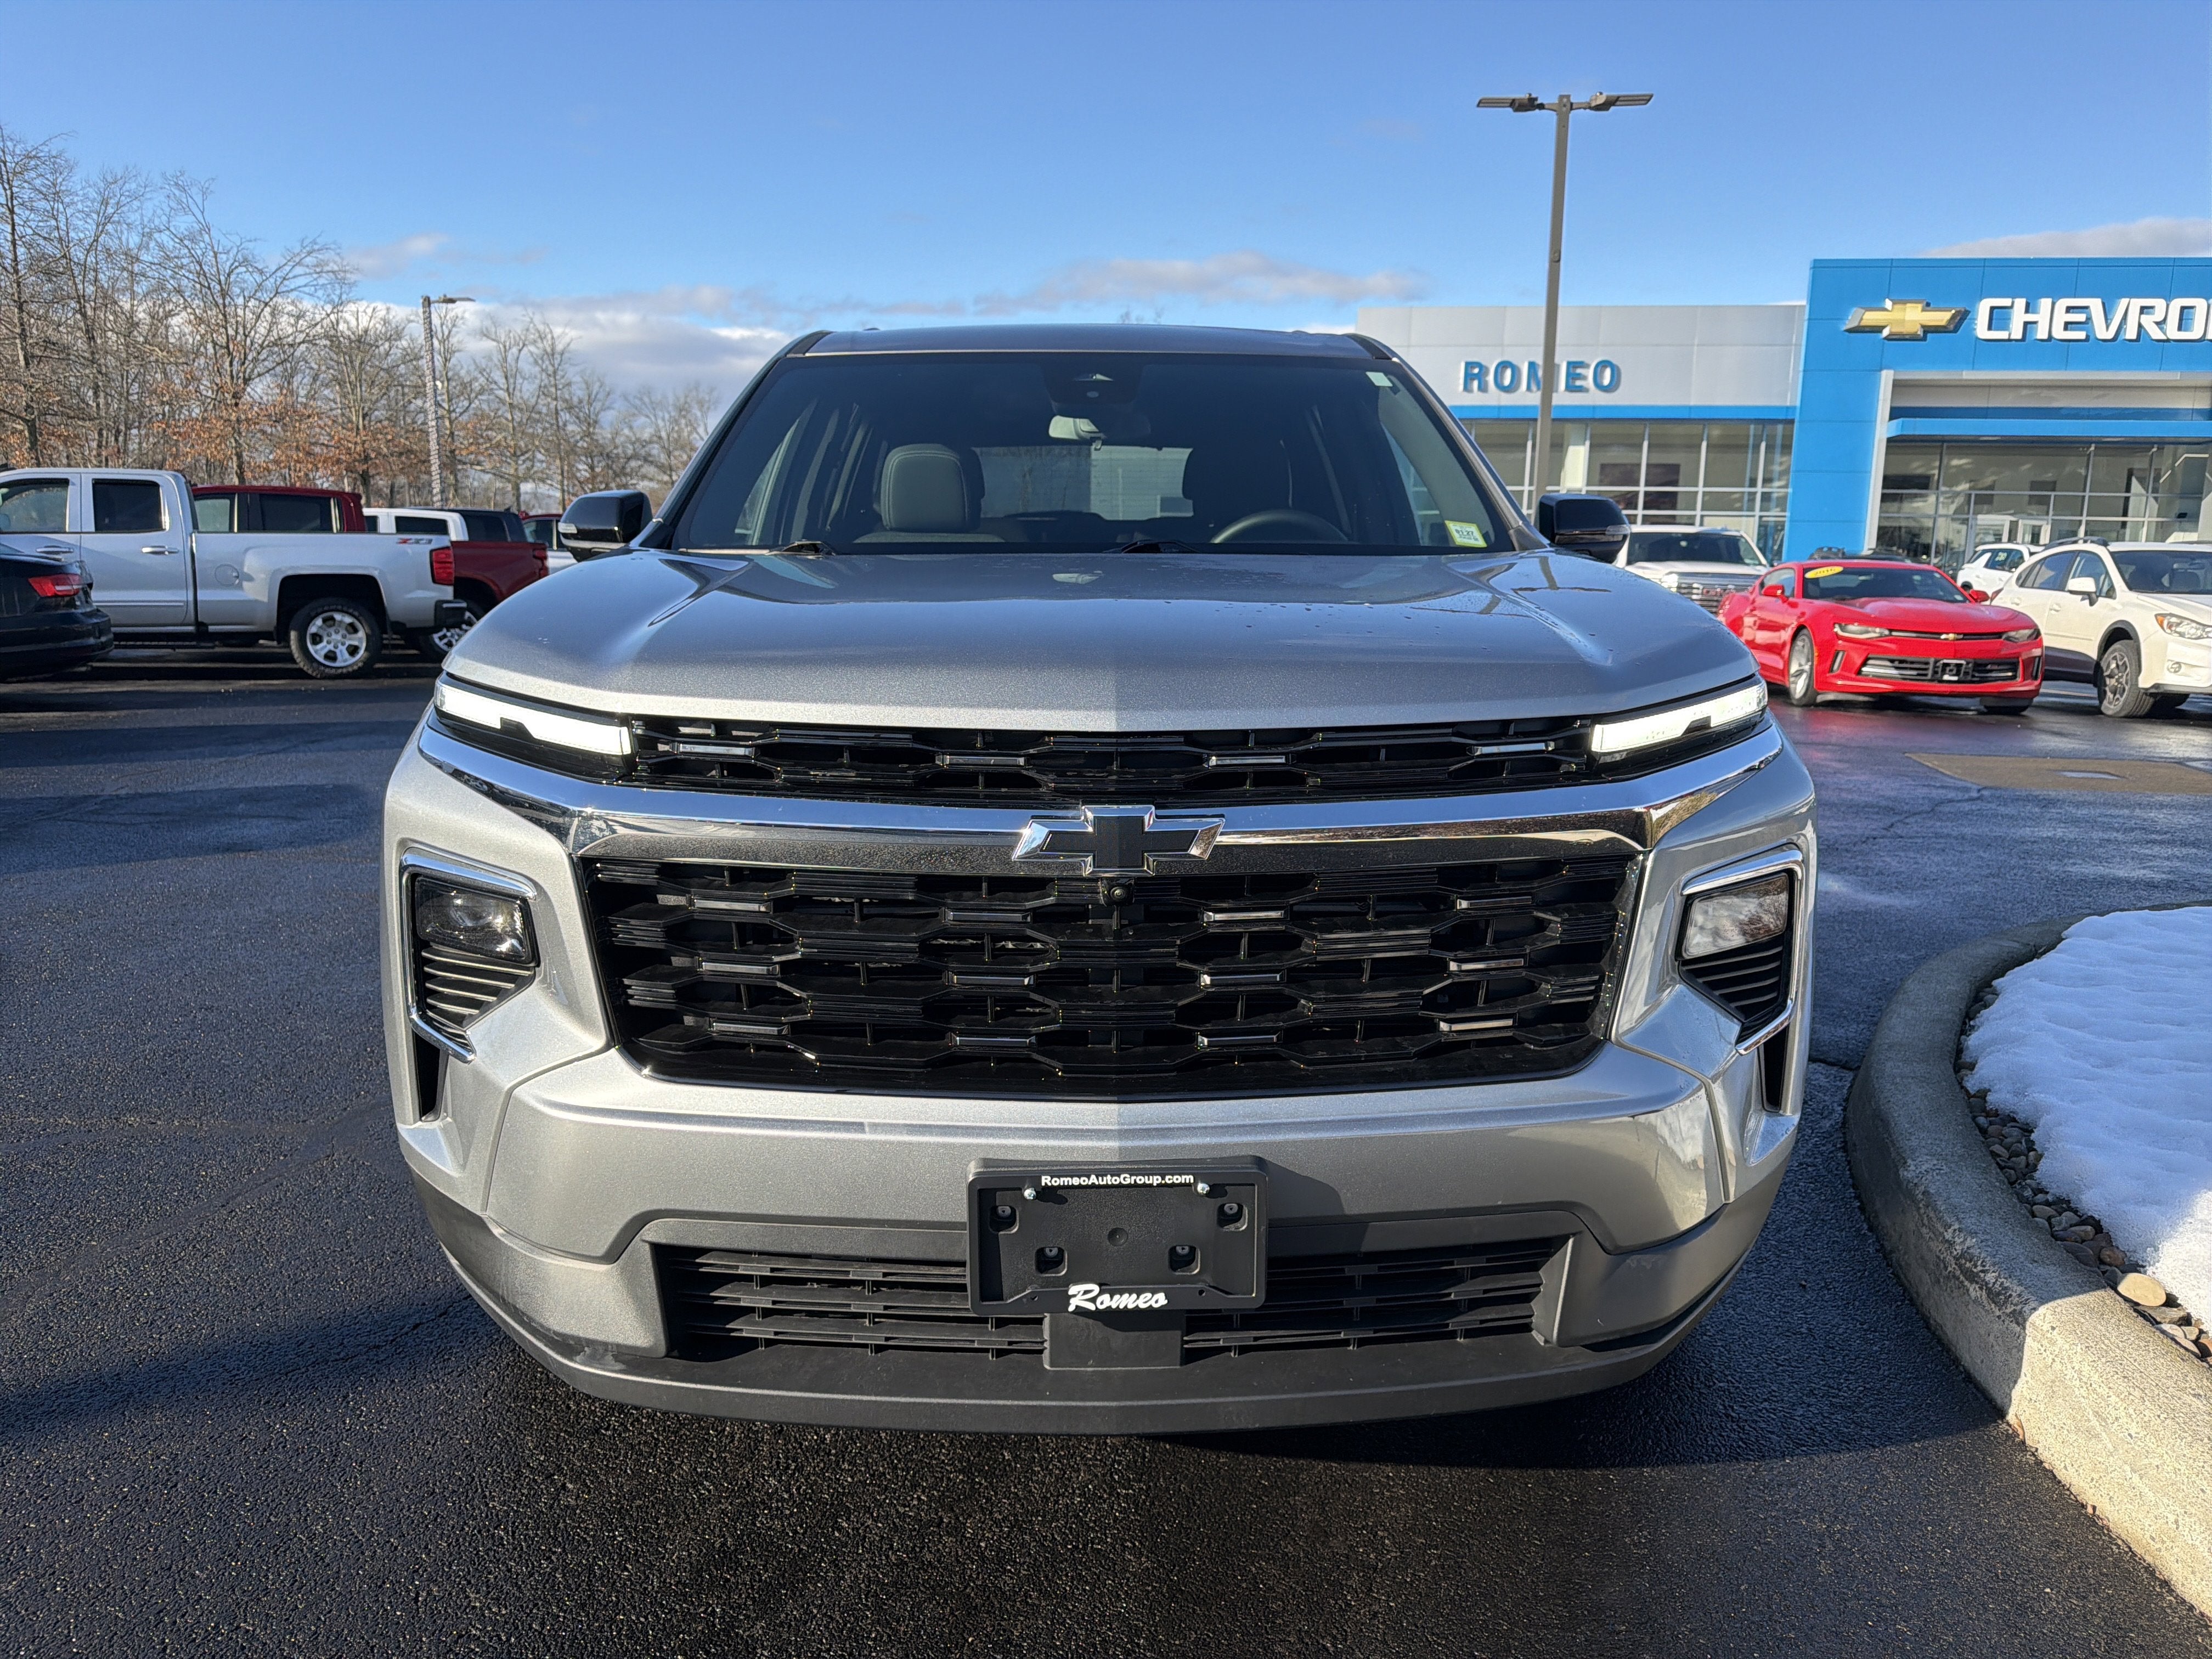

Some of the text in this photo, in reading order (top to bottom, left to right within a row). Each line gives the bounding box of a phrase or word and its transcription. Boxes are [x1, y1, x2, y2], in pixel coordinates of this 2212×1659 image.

[1977, 298, 2212, 341] CHEVRO
[1041, 1174, 1194, 1187] RomeoAutoGroup.com
[1068, 1283, 1168, 1312] Romeo
